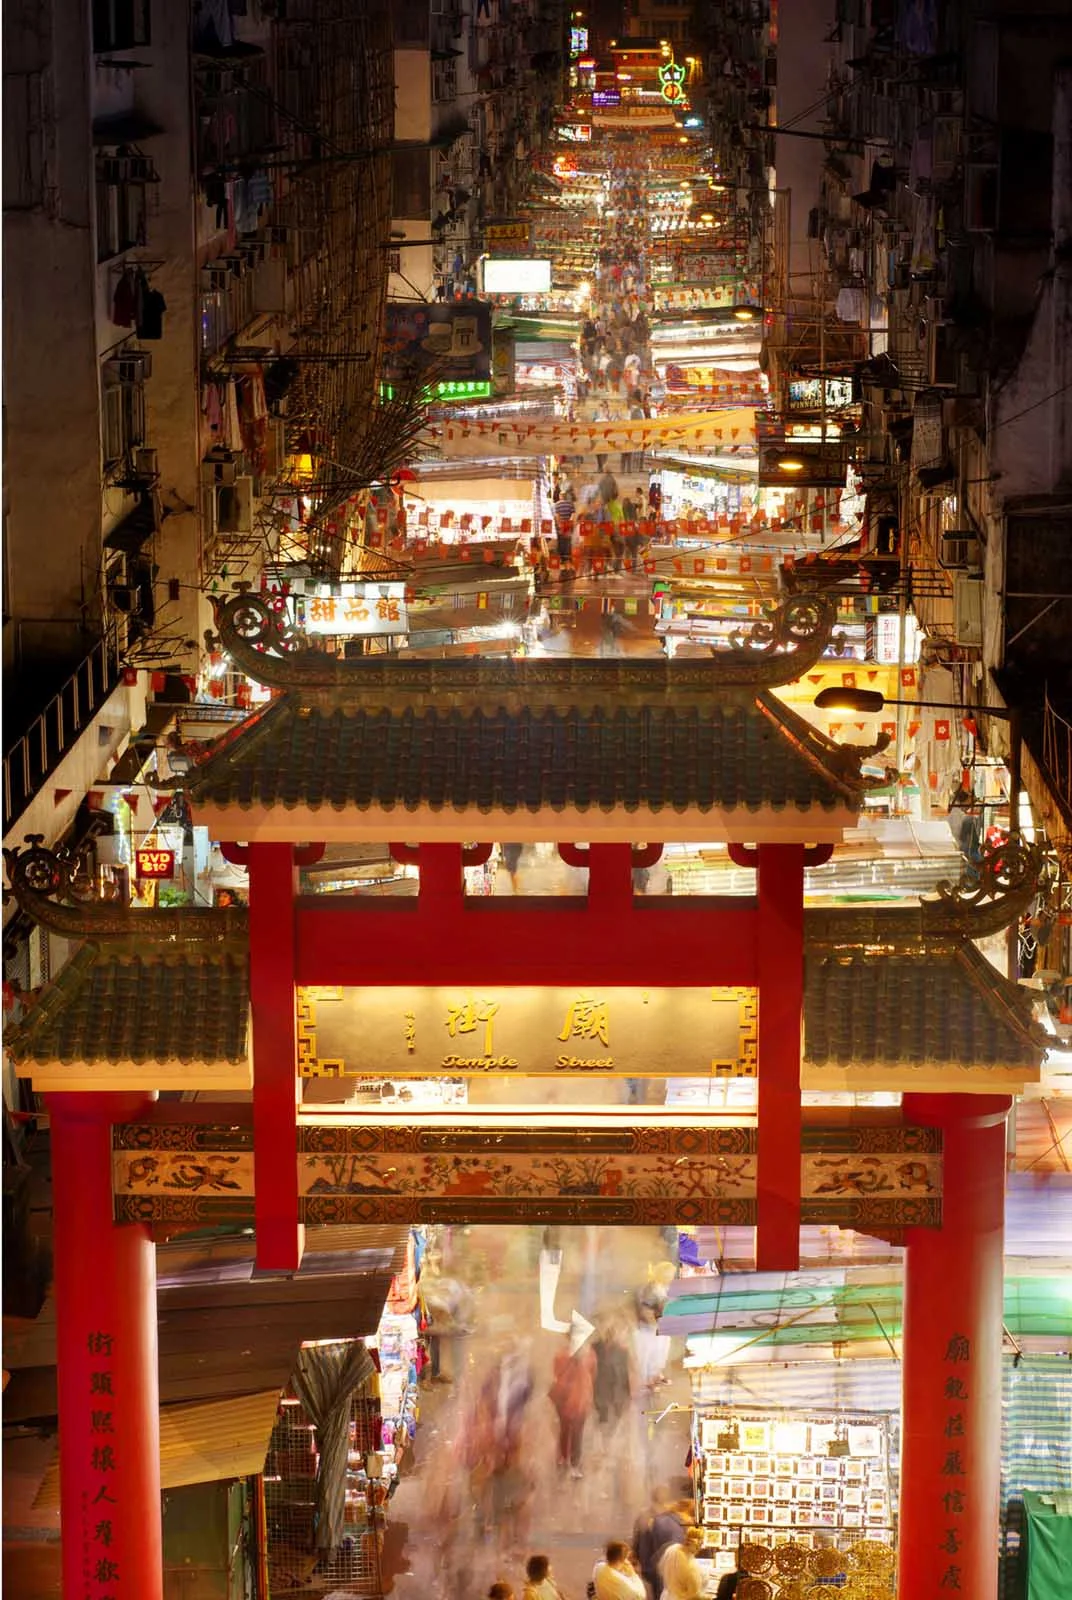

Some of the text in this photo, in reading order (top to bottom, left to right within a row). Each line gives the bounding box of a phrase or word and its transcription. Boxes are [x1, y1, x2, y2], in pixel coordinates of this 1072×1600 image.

[309, 595, 400, 623] 甜品館
[138, 852, 169, 863] DVD
[441, 1054, 615, 1071] Temple Street
